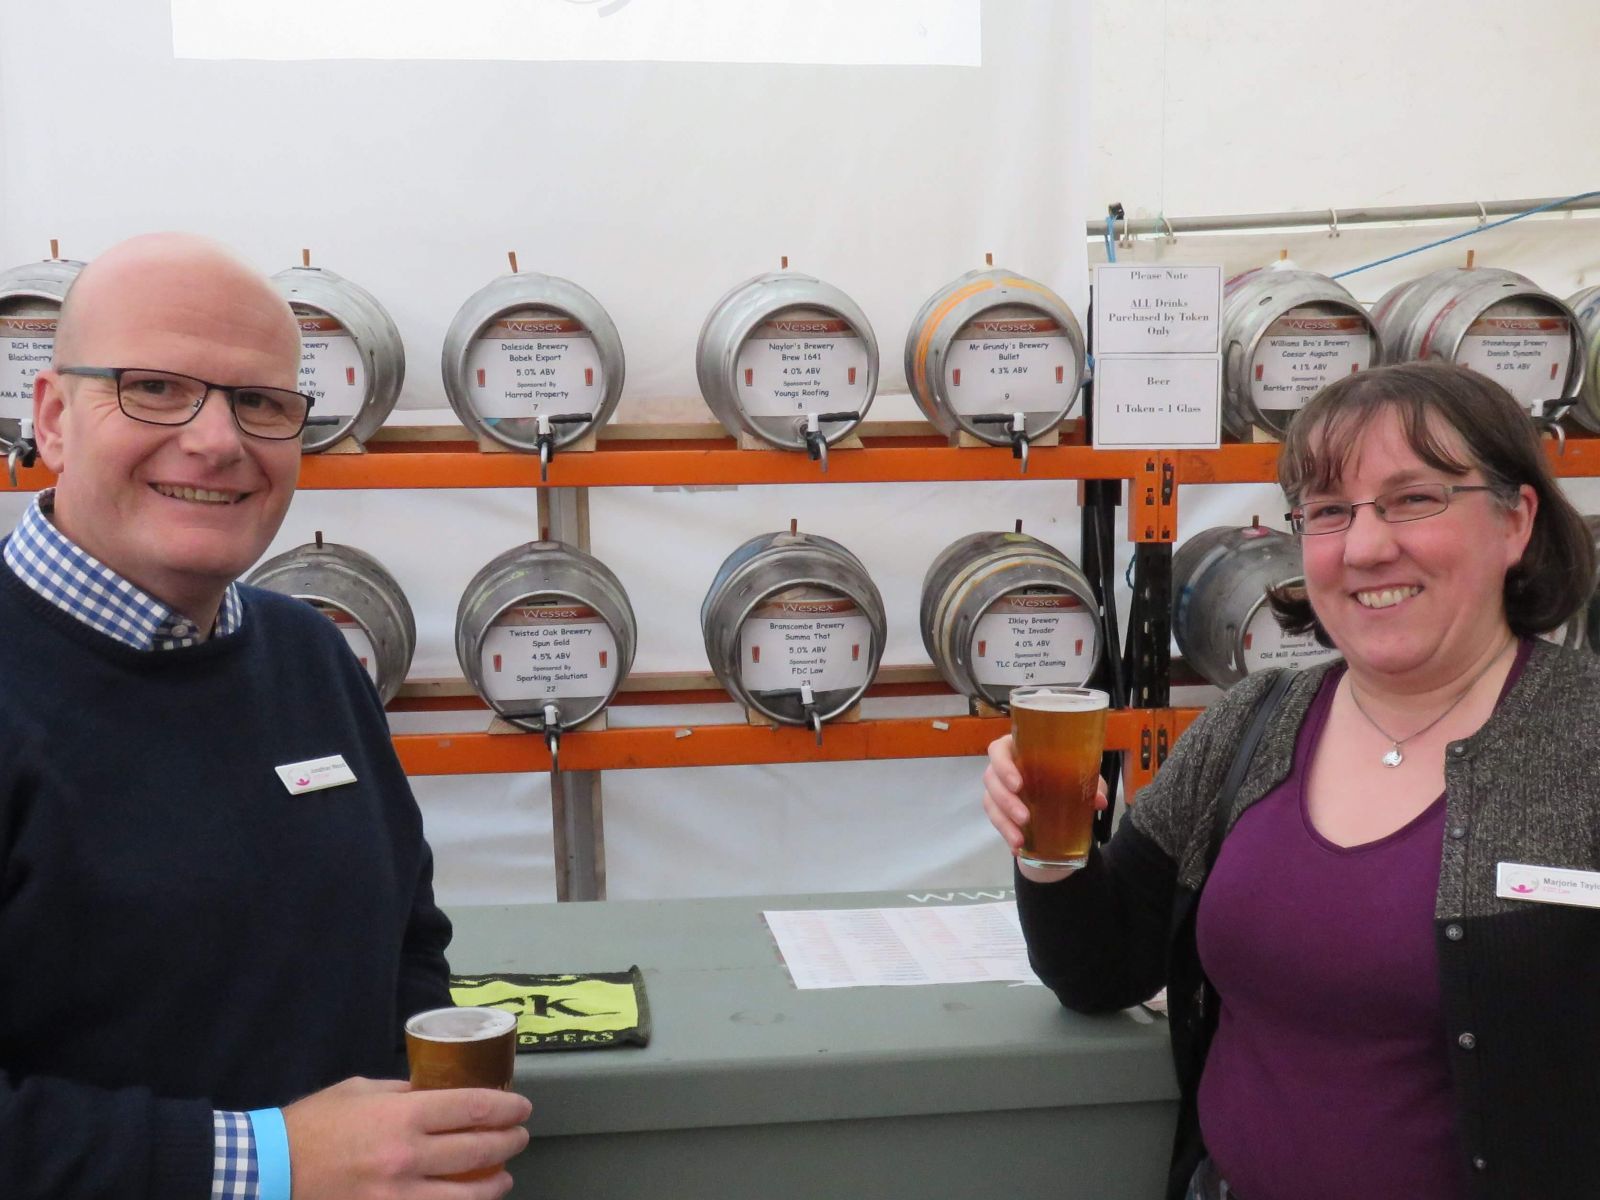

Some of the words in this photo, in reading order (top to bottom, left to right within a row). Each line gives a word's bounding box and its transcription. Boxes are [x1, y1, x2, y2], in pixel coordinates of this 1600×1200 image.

[1130, 271, 1162, 280] Please
[1166, 270, 1189, 280] Note
[1131, 299, 1152, 309] ALL
[1155, 298, 1189, 308] Drinks
[1108, 312, 1161, 322] Purchased
[1164, 312, 1176, 323] by
[1179, 312, 1209, 322] Token
[7, 320, 57, 330] Wesse
[506, 321, 562, 331] Wessex
[776, 321, 829, 331] Wessex
[983, 321, 1036, 331] Wessex
[1288, 320, 1338, 329] Wessex
[1147, 326, 1171, 336] Only
[501, 343, 534, 351] Daleside
[537, 343, 569, 351] Brewery
[768, 343, 801, 351] Naylor's
[804, 343, 835, 351] Brewery
[969, 343, 981, 351] Mr
[983, 343, 1016, 351] Grundy's
[1019, 341, 1050, 350] Brewery
[1324, 339, 1350, 348] Brewery
[8, 353, 52, 362] Blackberry
[535, 354, 562, 363] Export
[781, 353, 800, 361] Brew
[803, 353, 822, 361] 1641
[998, 353, 1020, 361] Bullet
[1281, 350, 1307, 358] Caesar
[1309, 350, 1339, 359] Augustus
[1513, 350, 1542, 358] Dynamite
[782, 367, 802, 375] 4.0%
[805, 367, 821, 375] ABV
[1012, 366, 1029, 374] ABV
[1312, 363, 1328, 371] ABV
[516, 368, 537, 376] 5.0%
[540, 368, 556, 376] ABV
[517, 381, 547, 389] Sponsored
[1147, 376, 1171, 386] Beer
[535, 391, 569, 400] Property
[774, 390, 800, 398] Youngs
[802, 389, 830, 397] Roofing
[1125, 404, 1156, 413] Token
[1176, 404, 1202, 413] Glass
[1010, 598, 1060, 607] Wessex
[782, 603, 834, 612] Wessex
[522, 608, 578, 618] Wessex
[769, 622, 814, 630] Branscombe
[816, 622, 845, 630] Brewery
[1008, 617, 1029, 626] Ilkley
[1031, 617, 1060, 625] Brewery
[509, 629, 540, 637] Twisted
[560, 628, 592, 637] Brewery
[1012, 627, 1026, 635] The
[1028, 627, 1055, 635] Invader
[785, 633, 811, 641] Summa
[532, 640, 551, 648] Spun
[553, 639, 571, 647] Gold
[1036, 640, 1051, 648] ABV
[811, 646, 827, 654] ABV
[555, 652, 571, 660] ABV
[996, 660, 1011, 669] TLC
[1012, 660, 1037, 669] Carpet
[1038, 659, 1066, 668] Cleaning
[791, 667, 808, 675] FDC
[810, 667, 824, 675] Law
[516, 674, 552, 683] Sparkling
[554, 672, 588, 681] Solutions
[546, 685, 556, 693] 22
[1543, 877, 1578, 888] Marjorie
